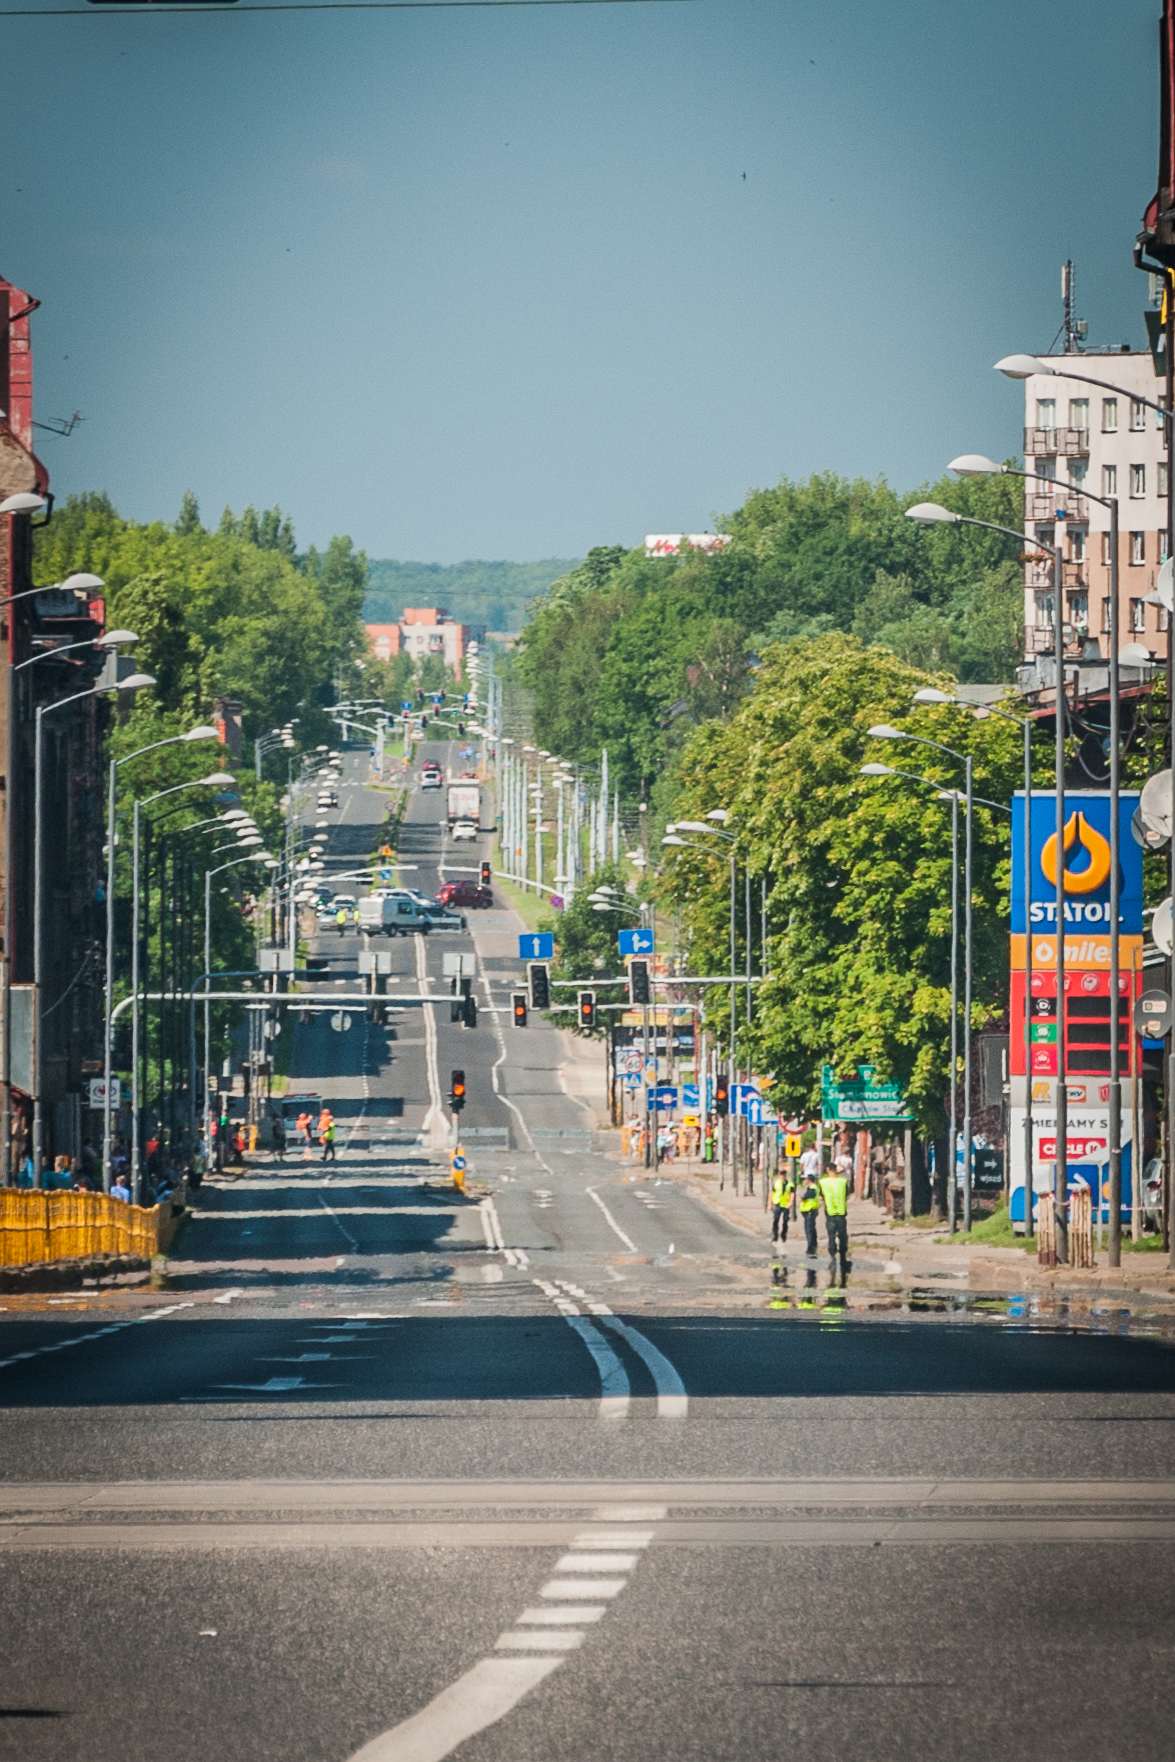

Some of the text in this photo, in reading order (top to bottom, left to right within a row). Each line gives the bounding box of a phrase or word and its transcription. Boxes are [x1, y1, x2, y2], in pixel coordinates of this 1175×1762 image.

[1062, 941, 1115, 962] mile
[1021, 1118, 1096, 1129] ZMIEAMY
[1042, 1143, 1084, 1155] CICLE
